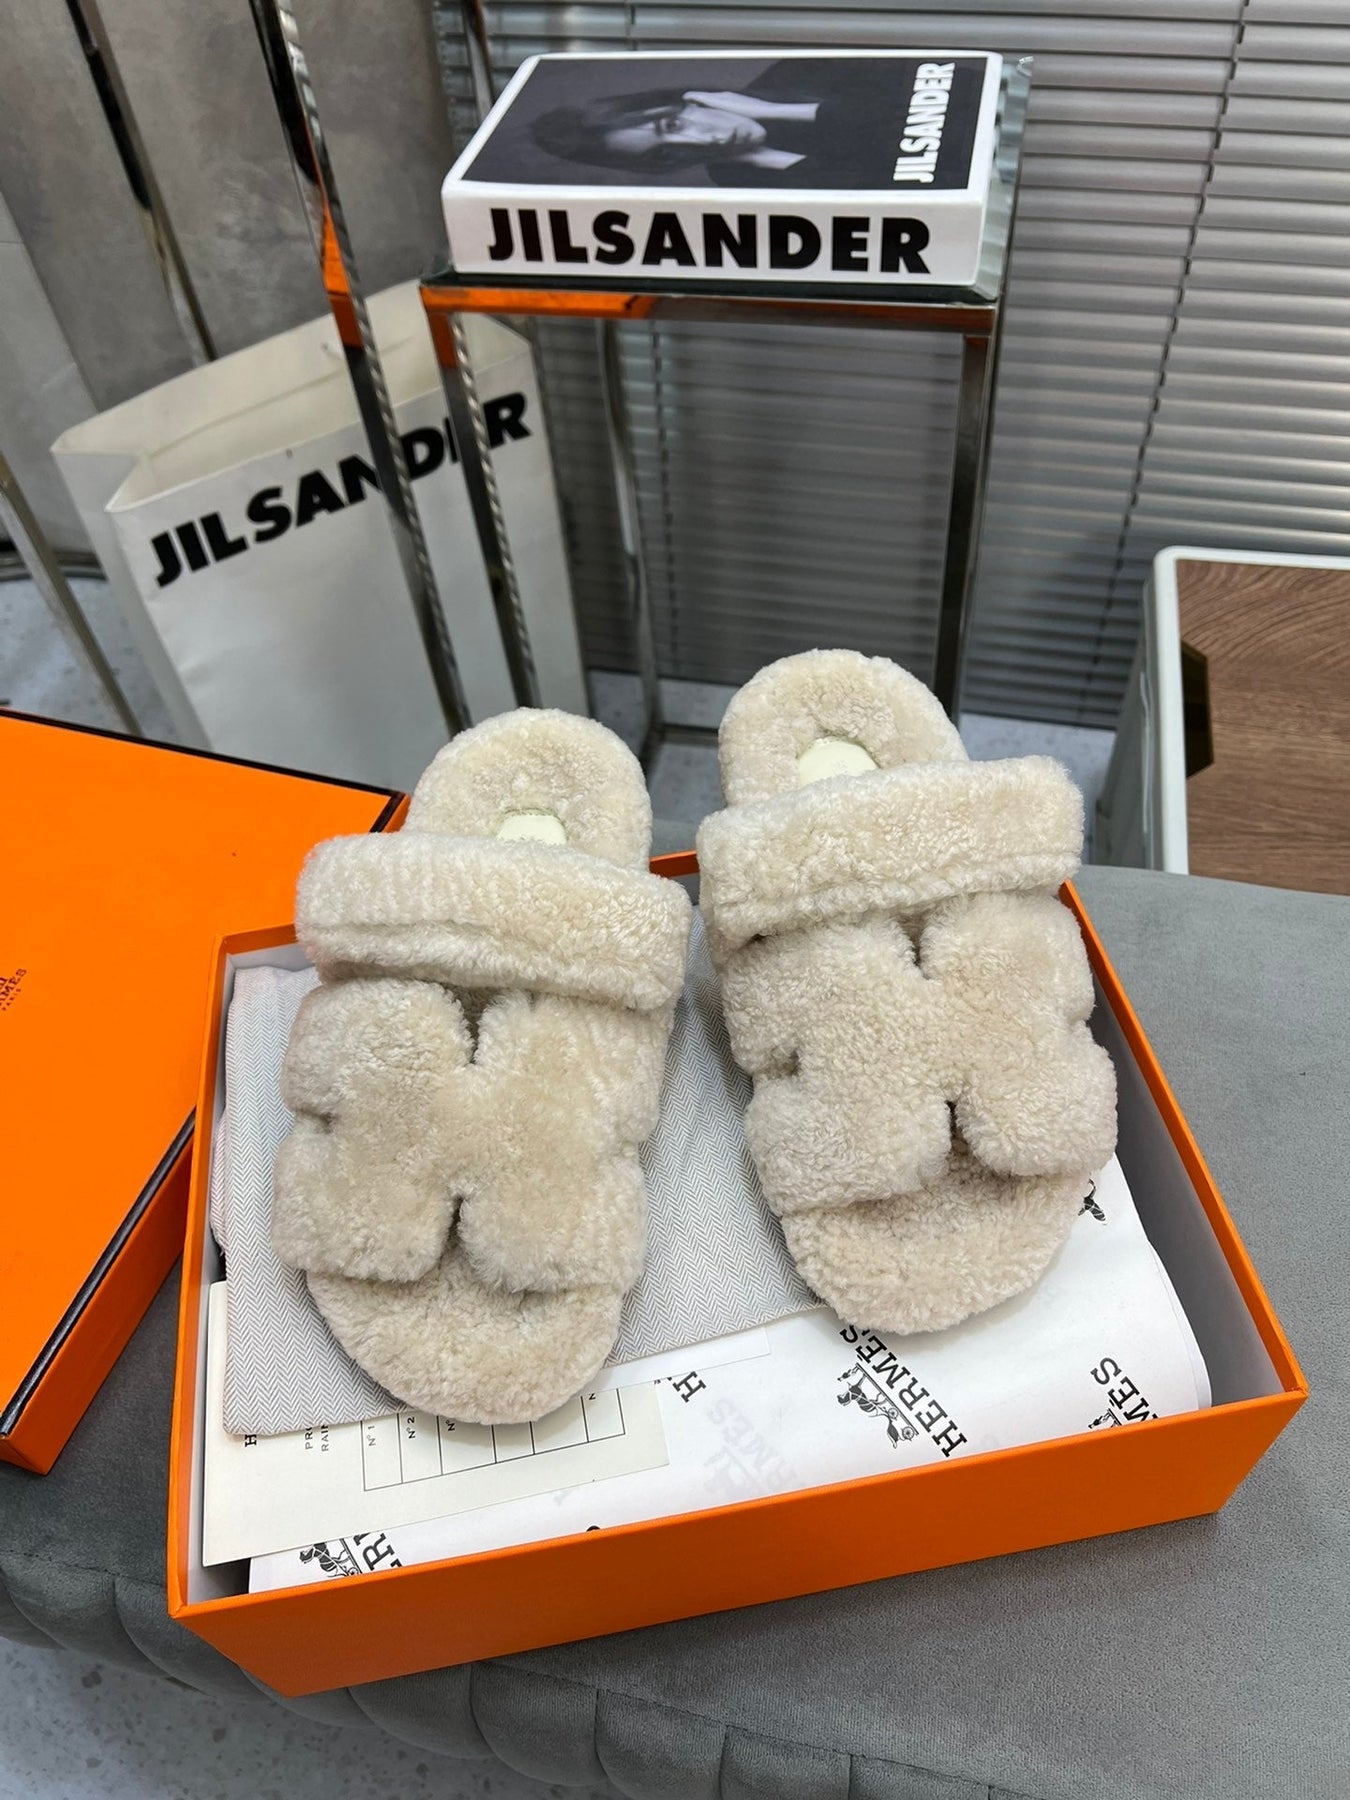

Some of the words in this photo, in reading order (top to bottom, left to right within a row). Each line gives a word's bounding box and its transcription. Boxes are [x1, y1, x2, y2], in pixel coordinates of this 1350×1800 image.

[893, 62, 955, 183] JILSANDER
[488, 208, 931, 274] JILSANDER
[151, 392, 532, 587] JILSANDR
